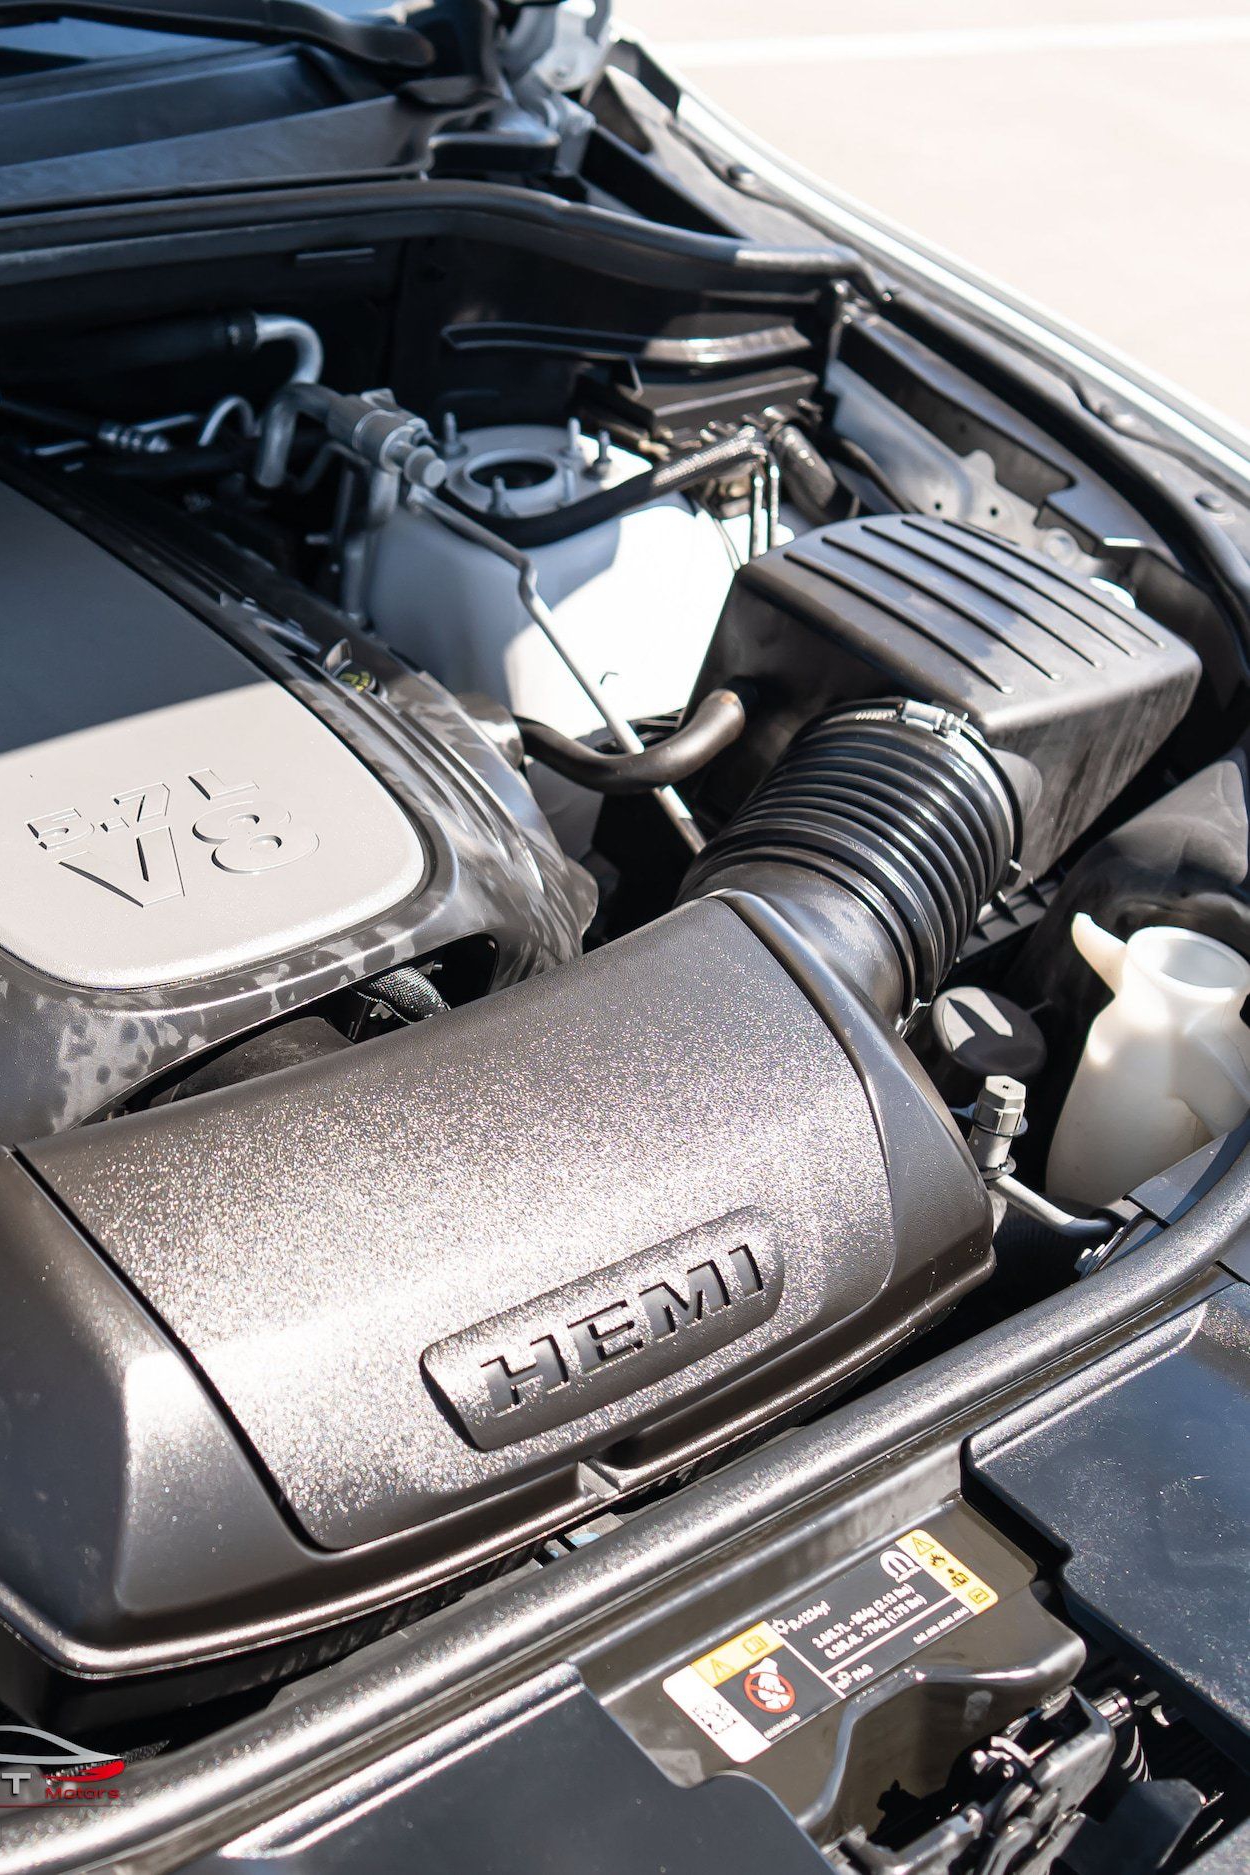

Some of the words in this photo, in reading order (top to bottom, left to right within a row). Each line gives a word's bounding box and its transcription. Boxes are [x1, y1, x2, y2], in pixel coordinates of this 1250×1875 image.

[24, 768, 260, 851] 5.7L
[54, 801, 320, 908] V8
[480, 1243, 764, 1418] HEMI
